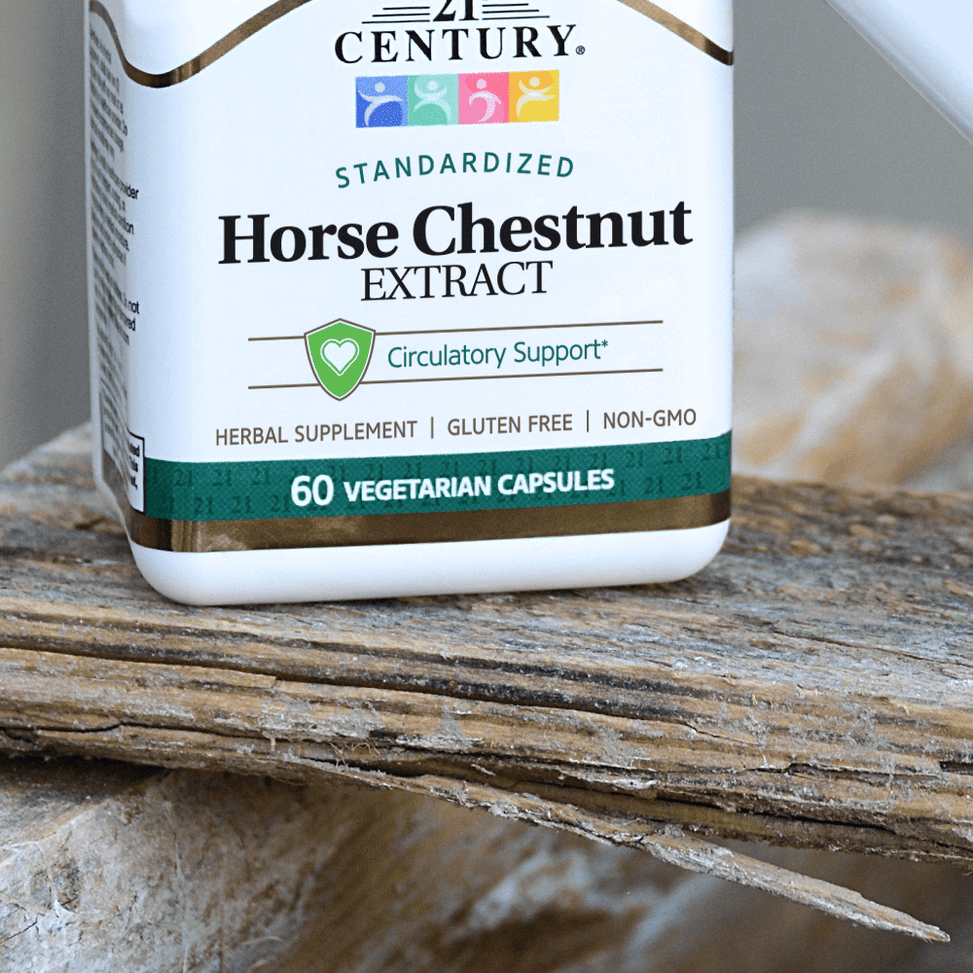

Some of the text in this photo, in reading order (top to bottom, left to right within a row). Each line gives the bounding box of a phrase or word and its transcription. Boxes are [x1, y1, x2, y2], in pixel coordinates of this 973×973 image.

[336, 152, 573, 188] STANDARDIZED
[219, 201, 693, 264] Horse Chestnut
[361, 261, 553, 301] EXTRACT
[388, 344, 506, 369] Circulatory
[216, 409, 696, 446] HERBAL SUPPLEMENT GLUTEN FREE NON-GMO
[291, 469, 614, 506] 60 VEGETARIAN CAPSULES
